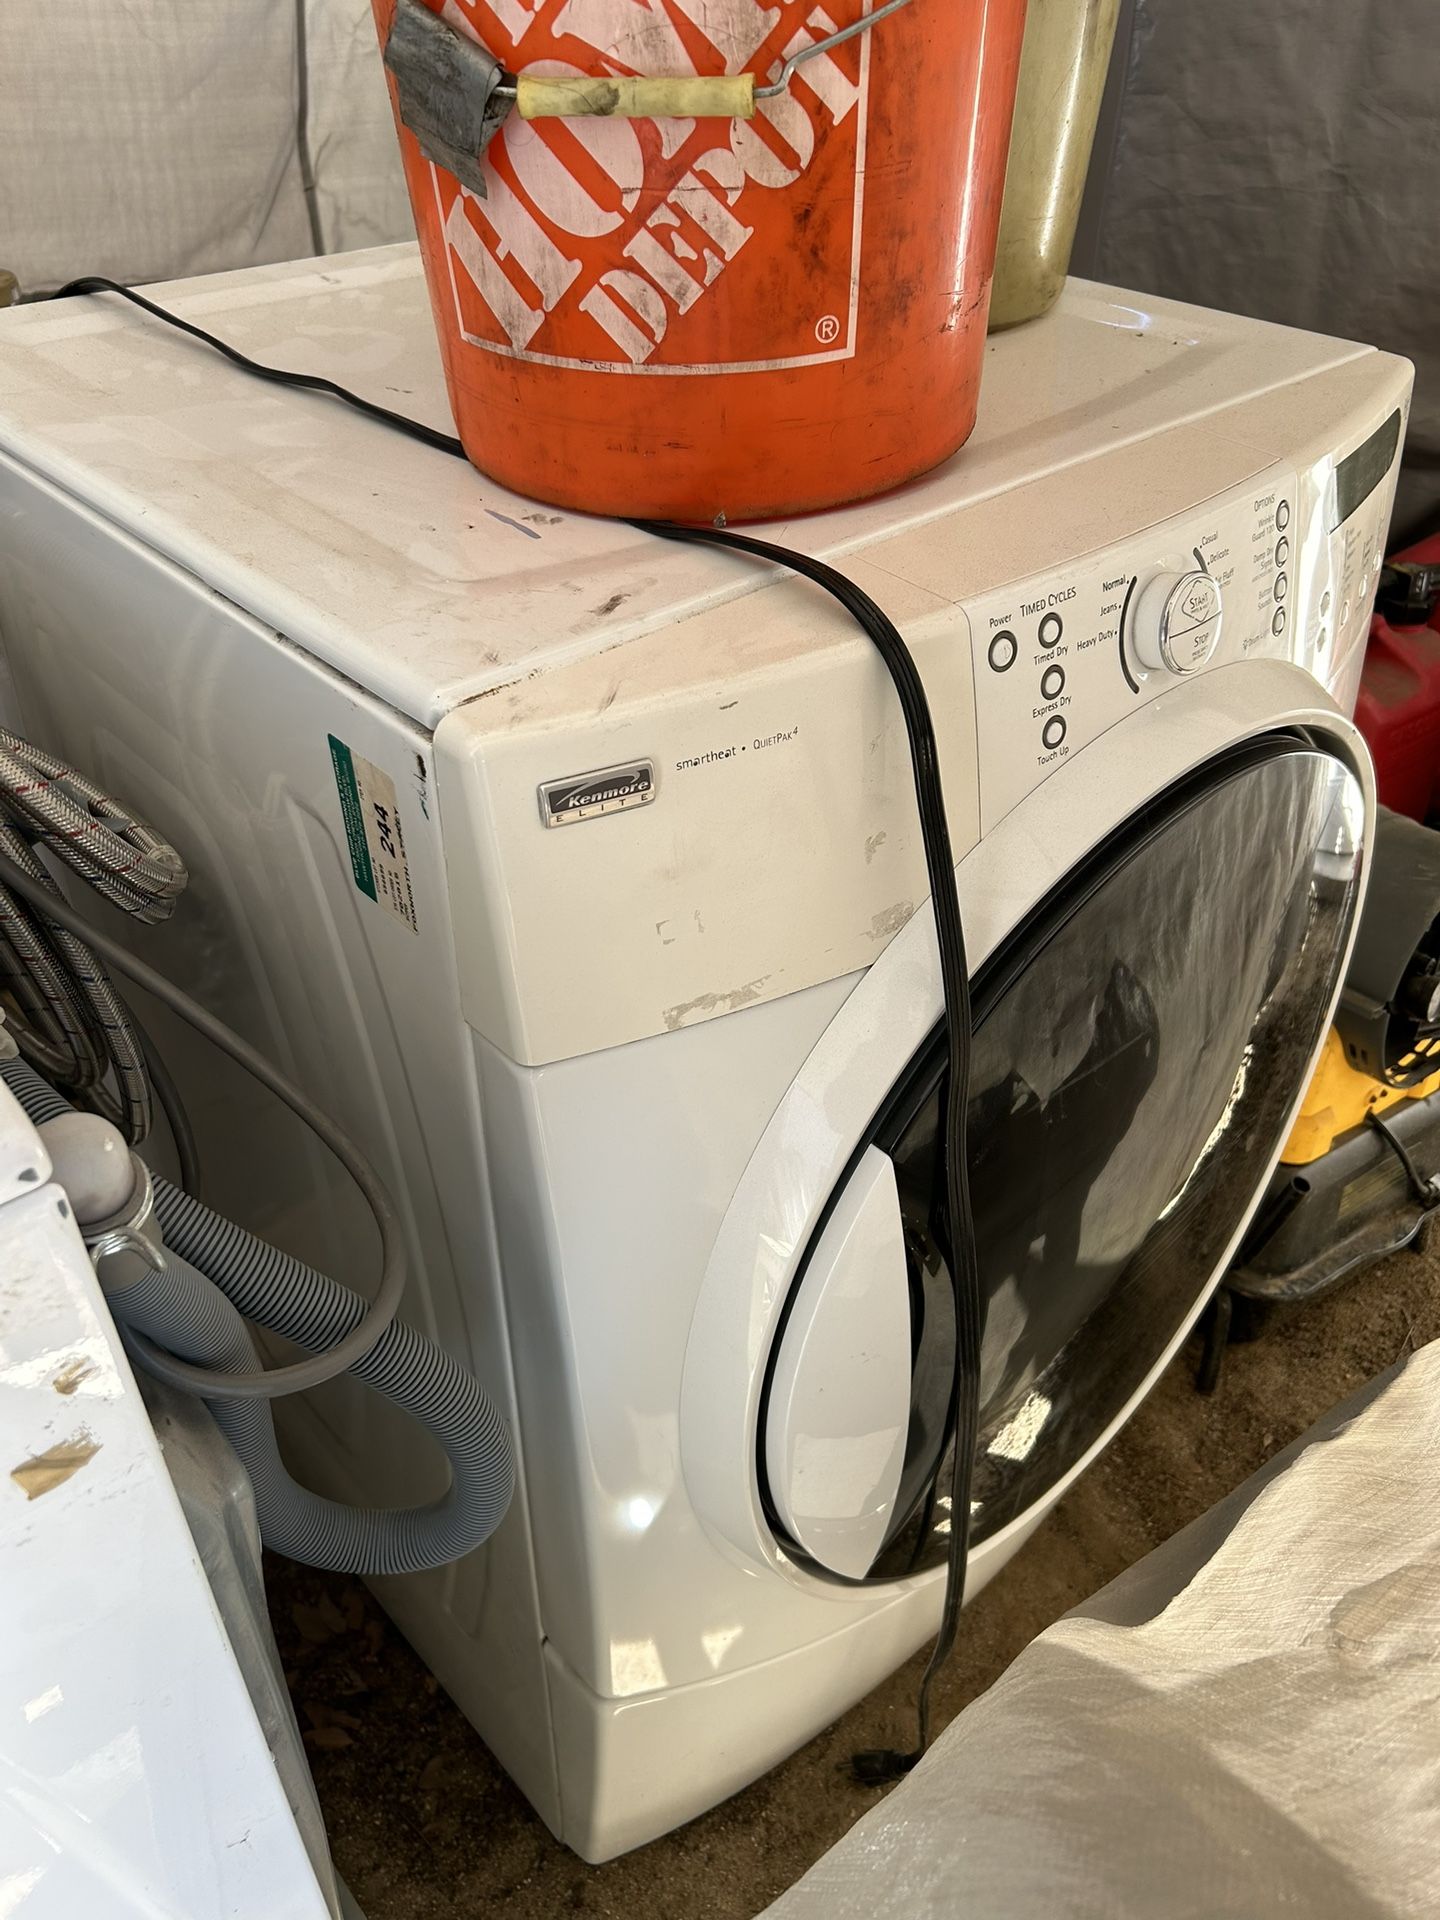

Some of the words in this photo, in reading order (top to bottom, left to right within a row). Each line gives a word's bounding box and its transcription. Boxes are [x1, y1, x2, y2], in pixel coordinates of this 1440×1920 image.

[446, 0, 800, 352] HOM
[578, 5, 860, 364] DEPOT
[1201, 531, 1218, 546] Casual
[1210, 548, 1230, 564] Delicate
[1102, 574, 1126, 592] Normal
[1020, 599, 1046, 617] TIMED
[1047, 586, 1077, 607] CYCLES
[1100, 602, 1118, 617] Jeans
[989, 614, 1012, 628] Power
[1076, 637, 1097, 651] Heavy
[1098, 629, 1114, 642] Duty
[1194, 632, 1209, 648] STOP
[1033, 650, 1054, 666] Timed
[1056, 645, 1069, 656] Dry
[1032, 701, 1058, 718] Express
[1060, 696, 1072, 707] Dry
[676, 746, 736, 771] smartheat
[1037, 751, 1058, 766] Touch
[1060, 745, 1070, 757] Up
[568, 780, 649, 808] Kenmore
[556, 793, 648, 822] ELITE
[373, 802, 395, 859] 244
